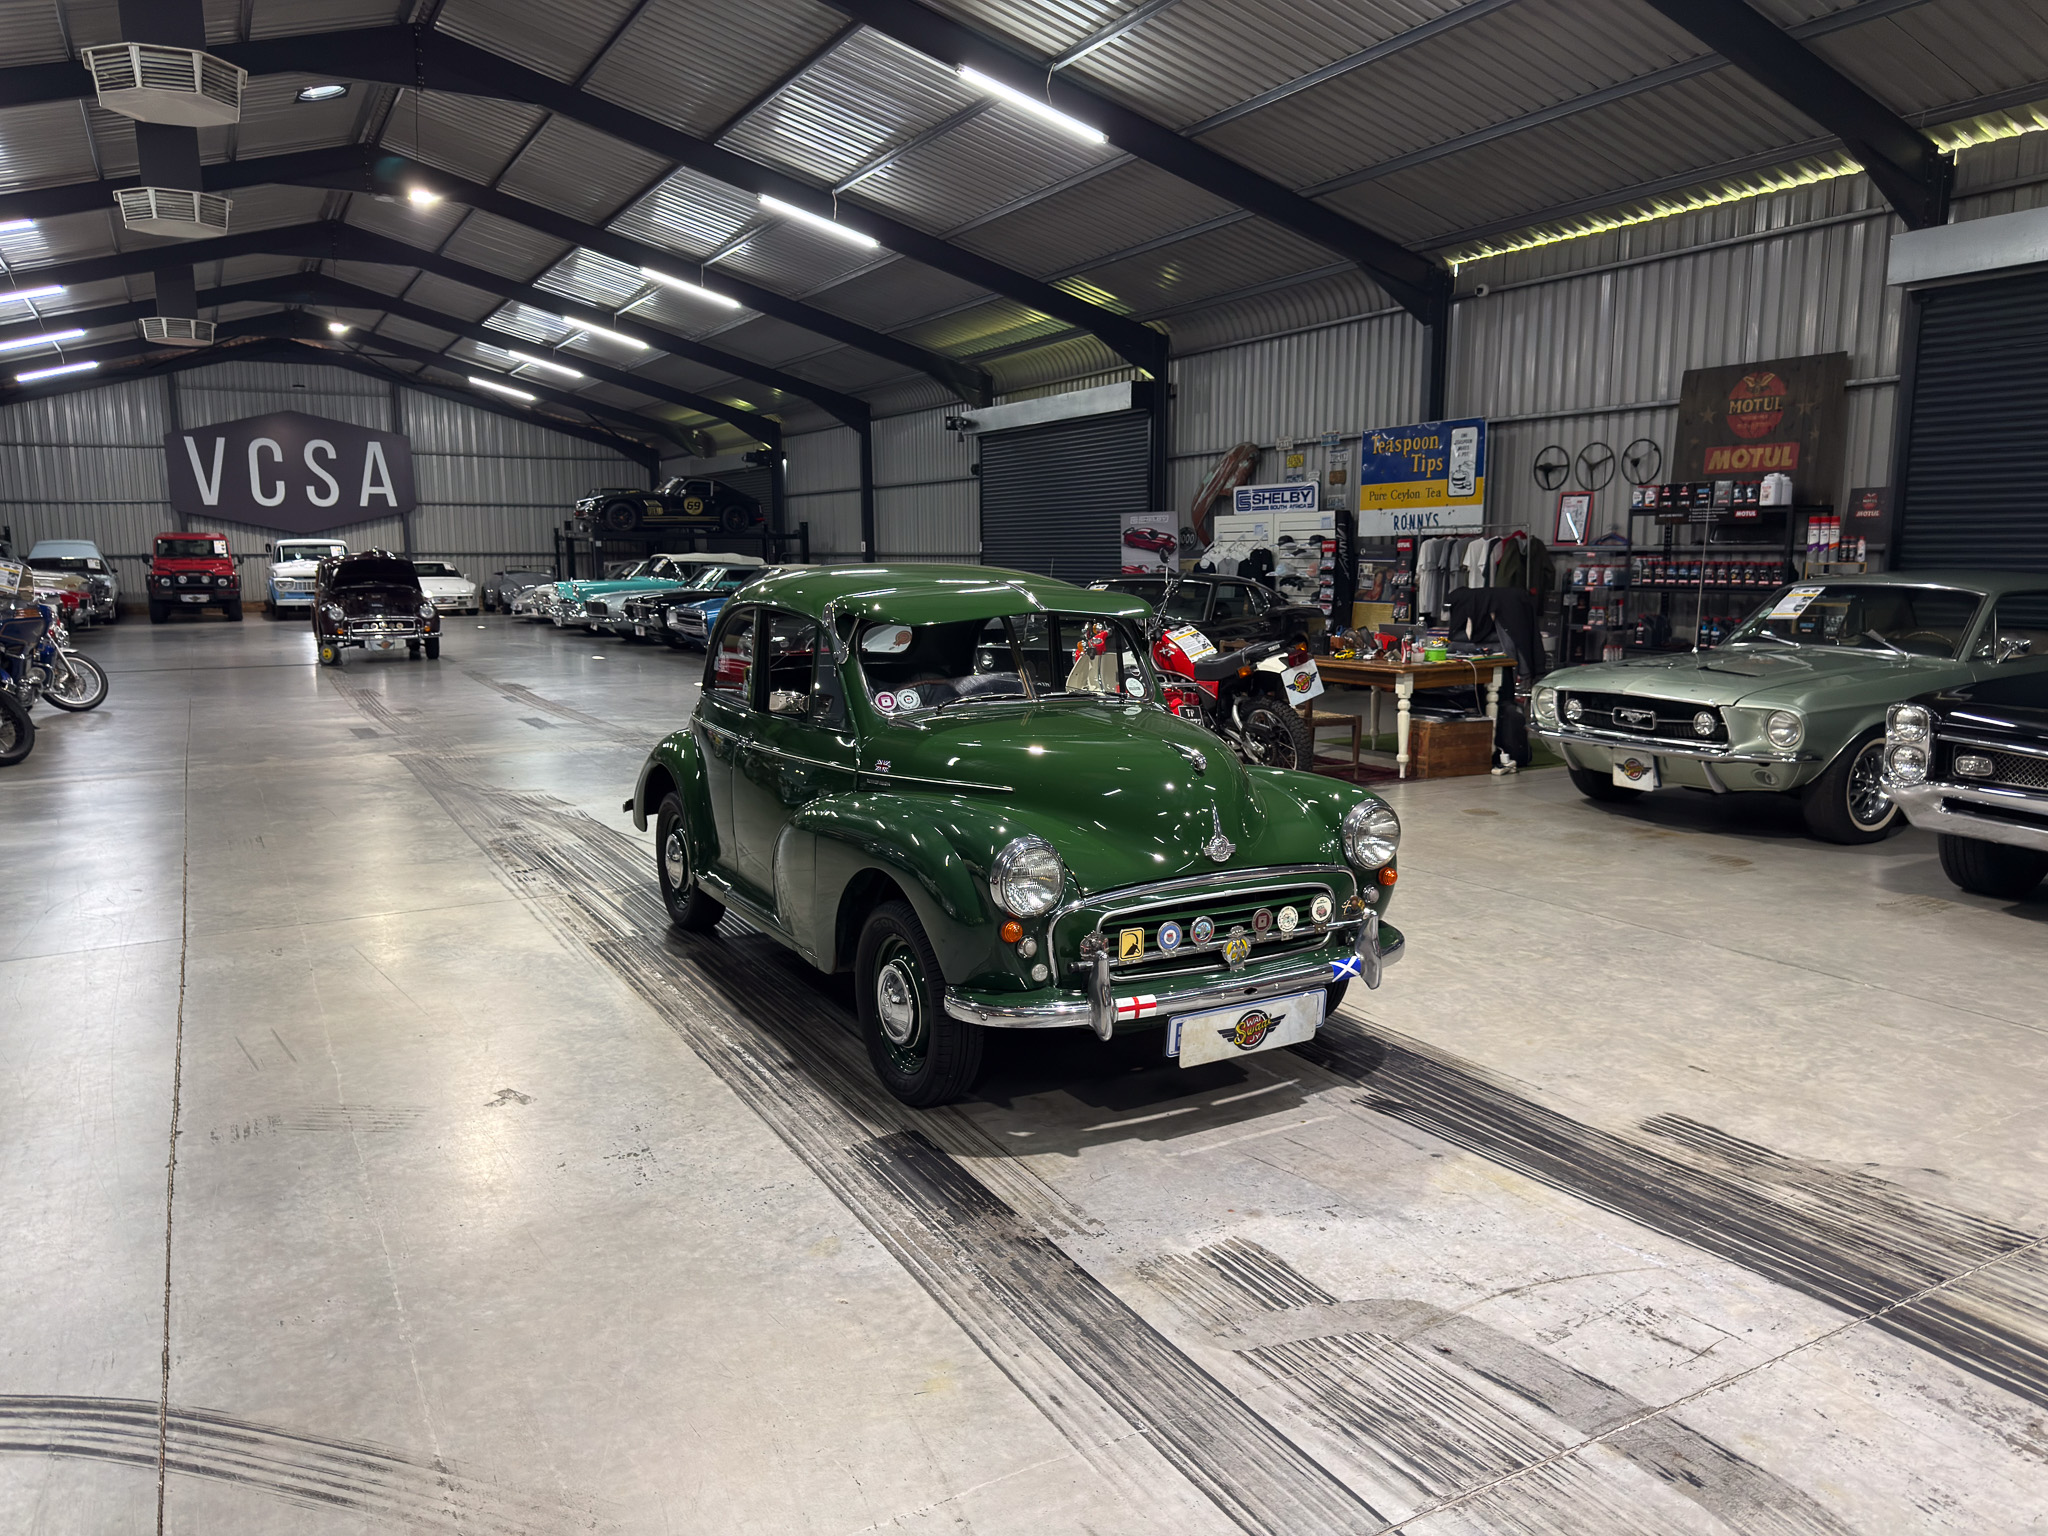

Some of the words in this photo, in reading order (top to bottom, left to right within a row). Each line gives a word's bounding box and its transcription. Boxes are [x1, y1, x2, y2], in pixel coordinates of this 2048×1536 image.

[1728, 396, 1783, 414] MOTUL
[1371, 434, 1440, 457] Teaspoon
[1411, 453, 1444, 478] Tips
[1707, 445, 1794, 471] MOTUL
[183, 435, 398, 508] VCSA
[1252, 490, 1311, 505] SHELBY
[1369, 490, 1388, 501] Pure
[1390, 488, 1420, 502] Ceylon
[1425, 487, 1441, 498] Tea
[686, 501, 701, 510] 69
[1393, 512, 1440, 531] RONNYS
[1159, 646, 1176, 657] XT
[1185, 709, 1195, 717] TP
